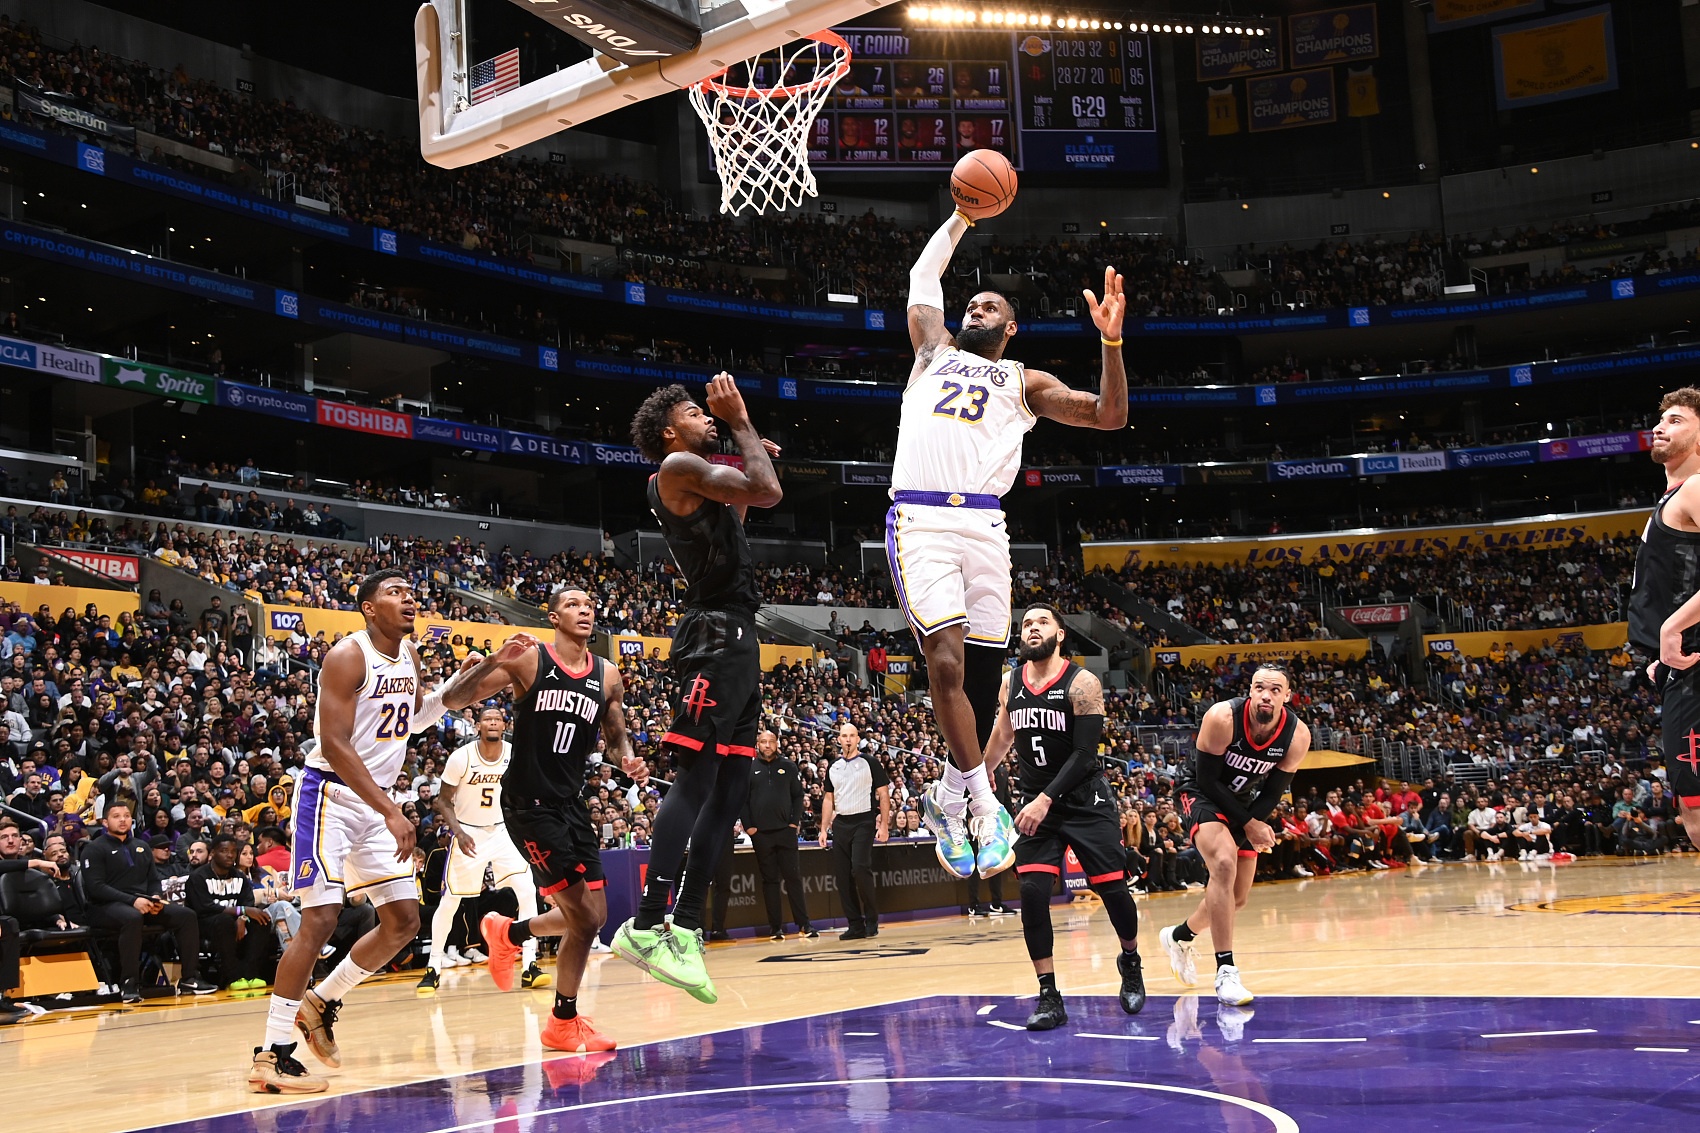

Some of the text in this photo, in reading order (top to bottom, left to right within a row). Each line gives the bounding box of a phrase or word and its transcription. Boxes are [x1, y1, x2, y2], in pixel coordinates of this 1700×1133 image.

[563, 13, 638, 48] DWS
[1296, 34, 1315, 42] WNBA
[864, 36, 910, 55] COURT
[1056, 41, 1070, 58] 20
[1072, 41, 1086, 58] 29
[1088, 41, 1102, 58] 32
[1108, 41, 1117, 58] 9
[1128, 40, 1142, 58] 90
[1296, 34, 1372, 54] CHAMPIONS
[1351, 45, 1372, 55] 2002
[1202, 46, 1276, 66] CHAMPIONS
[1255, 58, 1276, 68] 2001
[874, 67, 882, 82] 7
[928, 68, 944, 84] 26
[988, 68, 1000, 84] 11
[1058, 67, 1144, 86] 28 27 20 10 85
[240, 81, 254, 92] 303
[872, 84, 884, 94] PTS
[930, 84, 944, 95] PTS
[988, 84, 1000, 95] PTS
[854, 98, 884, 108] REDDISH
[915, 98, 939, 108] JAMES
[964, 98, 1006, 109] HACHIMURA
[1034, 96, 1053, 104] Lakers
[1072, 96, 1106, 118] 6:29
[1120, 96, 1142, 105] Rockets
[1254, 97, 1329, 118] CHAMPIONS
[40, 100, 107, 132] Spectrum
[1033, 106, 1044, 116] TOL
[1124, 106, 1135, 116] TOL
[1308, 110, 1330, 120] 2016
[816, 118, 829, 135] 18
[874, 119, 888, 136] 12
[936, 120, 944, 136] 2
[991, 120, 1004, 136] 17
[1034, 117, 1044, 127] FLS
[1076, 118, 1100, 128] QUARTER
[1124, 117, 1136, 128] FLS
[816, 136, 829, 146] PTS
[876, 136, 888, 146] PTS
[934, 136, 946, 146] PTS
[992, 136, 1004, 146] PTS
[853, 150, 876, 160] SMITH
[918, 150, 942, 160] EASON
[1066, 144, 1114, 154] ELEVATE
[1066, 155, 1115, 163] EVERY EVENT
[132, 167, 288, 219] CRYPTO.COM ARENA IS BETTER
[4, 230, 185, 283] CRYPTO.COM ARENA IS BETTER
[419, 246, 548, 282] CRYPTO.COM ARENA BETTER
[666, 294, 720, 310] CRYPTO.COM
[1391, 304, 1447, 318] CRYPTO.COM
[1492, 298, 1526, 310] BETTER
[318, 308, 466, 346] CRYPTO.COM ARENA IS BETTER
[1144, 321, 1197, 330] CRYPTO.COM
[42, 352, 95, 376] Health
[576, 360, 632, 375] CRYPTO.COM
[634, 366, 662, 379] ARENA
[676, 372, 708, 382] BETTER
[1552, 361, 1613, 376] CRYPTO.COM
[1616, 356, 1648, 368] ARENA
[930, 359, 1008, 387] LAKERS
[156, 373, 204, 396] Sprite
[1296, 384, 1352, 396] CRYPTO.COM
[1354, 382, 1384, 392] ARENA
[1397, 379, 1431, 390] BETTER
[816, 387, 900, 398] CRYPTO.COM ARENA
[246, 391, 306, 413] crypto.com
[932, 380, 990, 426] 23
[322, 405, 408, 434] TOSHIBA
[462, 430, 498, 446] ULTRA
[1578, 438, 1605, 448] VICTORY
[1607, 435, 1630, 445] TASTES
[528, 439, 580, 458] DELTA
[1587, 444, 1624, 454] LIKE TACOS
[1368, 456, 1442, 470] UCLA Health
[1474, 449, 1530, 464] crypto.com
[852, 474, 888, 483] Happy 7th
[1043, 474, 1081, 482] TOYOTA
[1116, 469, 1164, 477] AMERICAN
[1278, 462, 1344, 480] Spectrum
[1122, 476, 1164, 484] EXPRESS
[1248, 526, 1586, 562] LOS ANGELES LAKERS
[275, 614, 298, 628] 102
[621, 642, 640, 654] 103
[1430, 642, 1452, 652] 106
[888, 662, 908, 674] 104
[369, 674, 414, 699] LAKERS
[535, 690, 600, 724] HOUSTON
[376, 703, 409, 742] 28
[1010, 706, 1066, 732] HOUSTON
[553, 721, 576, 754] 10
[1031, 736, 1048, 767] 5
[1228, 775, 1248, 792] 9
[480, 788, 494, 808] 5
[1065, 878, 1088, 888] TOYOTA
